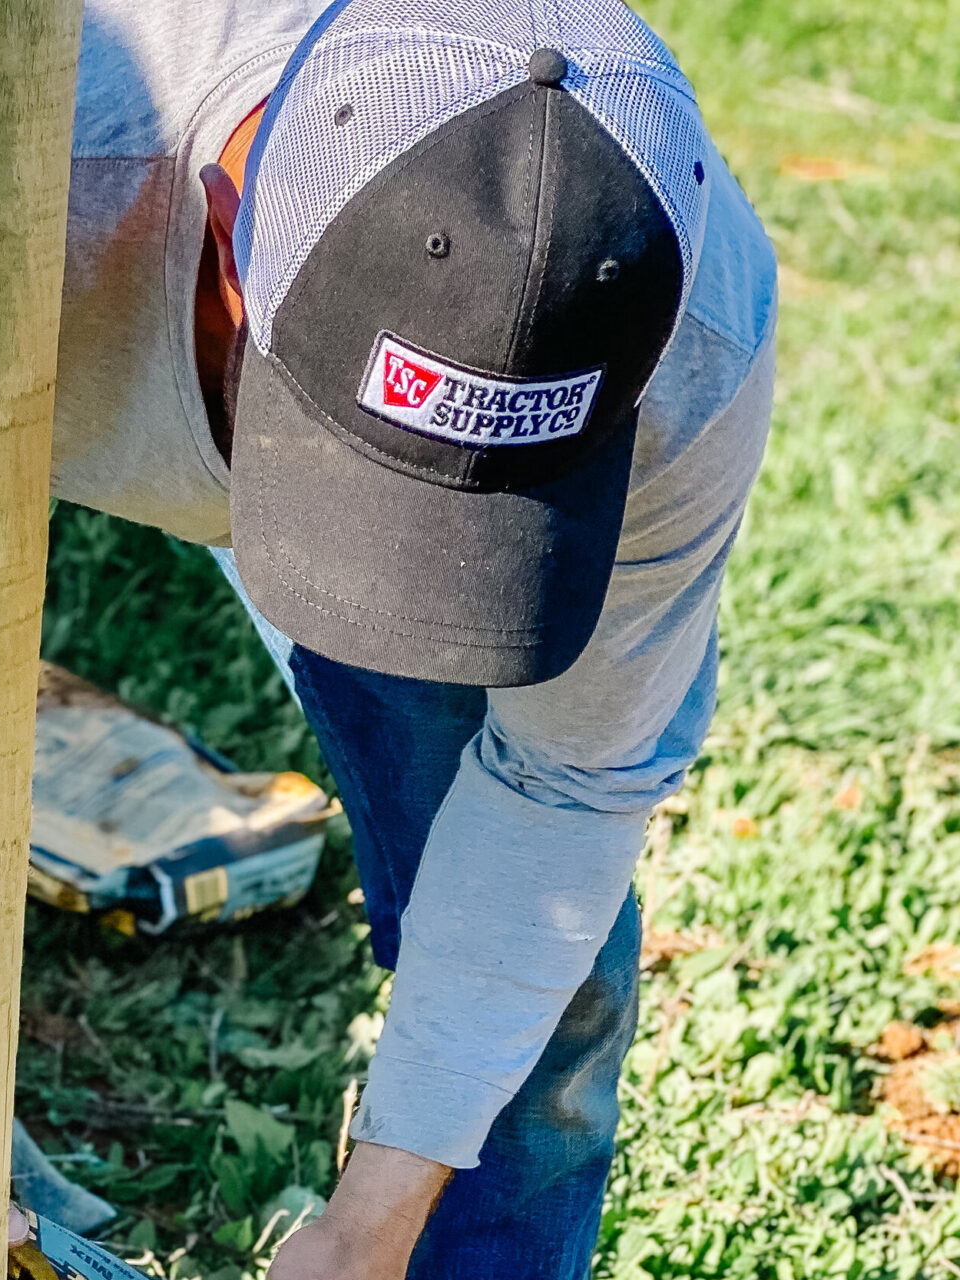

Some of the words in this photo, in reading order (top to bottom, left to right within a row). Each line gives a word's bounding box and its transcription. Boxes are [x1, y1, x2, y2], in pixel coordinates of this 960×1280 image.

[386, 355, 427, 405] TSC
[444, 377, 587, 412] TRACTOR
[430, 404, 550, 438] SUPPLY
